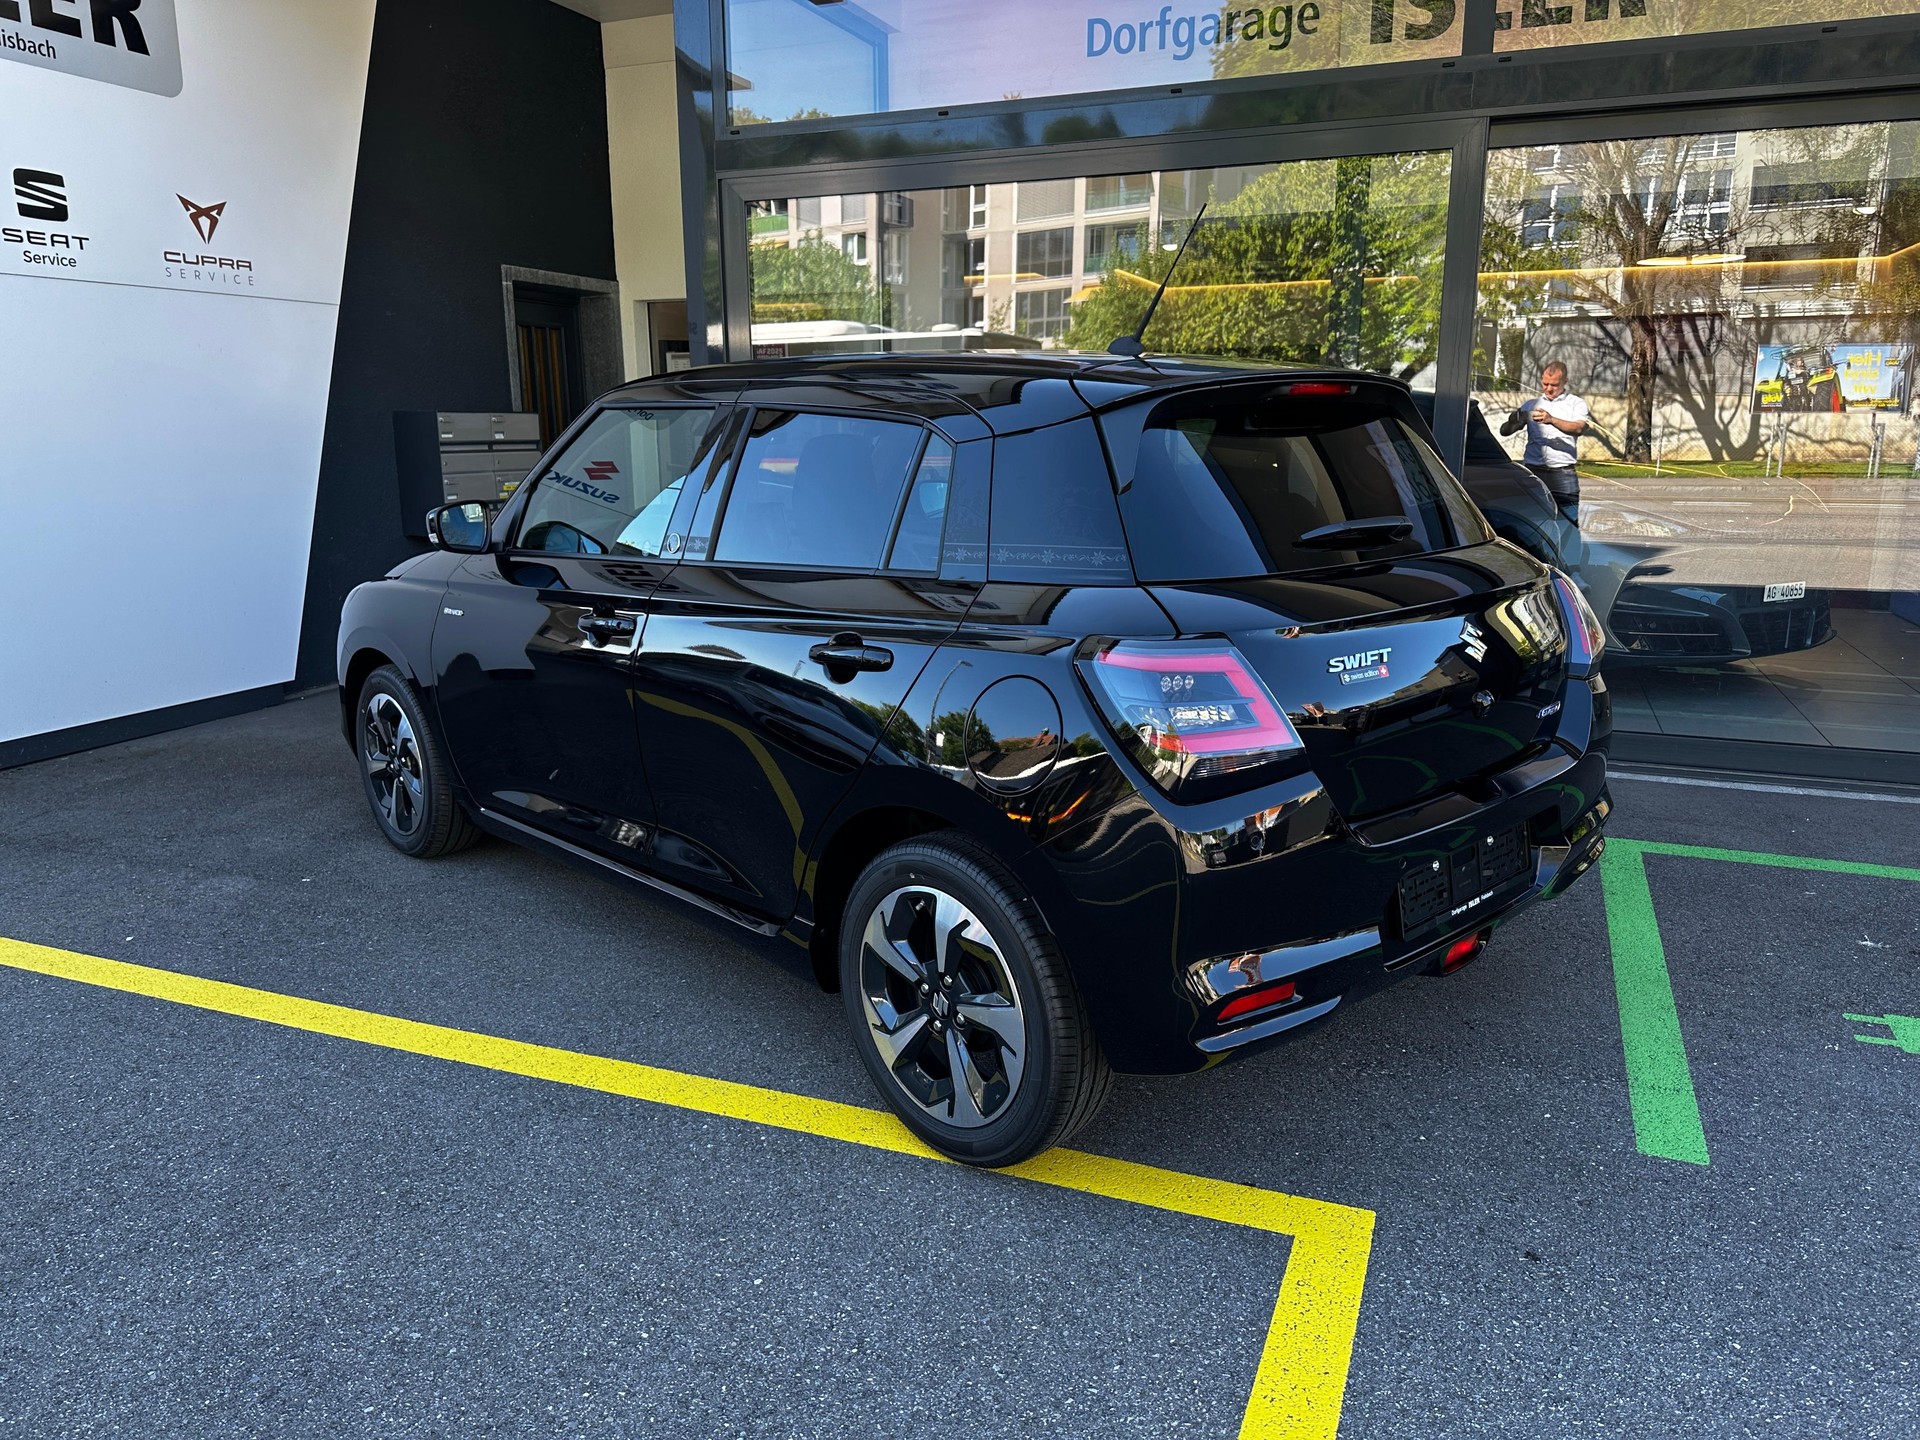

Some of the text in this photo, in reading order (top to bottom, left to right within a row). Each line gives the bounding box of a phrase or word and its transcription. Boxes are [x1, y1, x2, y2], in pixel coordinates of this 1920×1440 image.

[1086, 1, 1320, 61] Dorfgarage
[0, 29, 57, 59] isbach
[1, 227, 90, 250] SEAT
[22, 250, 78, 268] Service
[163, 250, 254, 272] CUPRA
[165, 266, 255, 286] SERVICE
[1781, 584, 1803, 597] 40855
[1328, 647, 1392, 673] SWIFT
